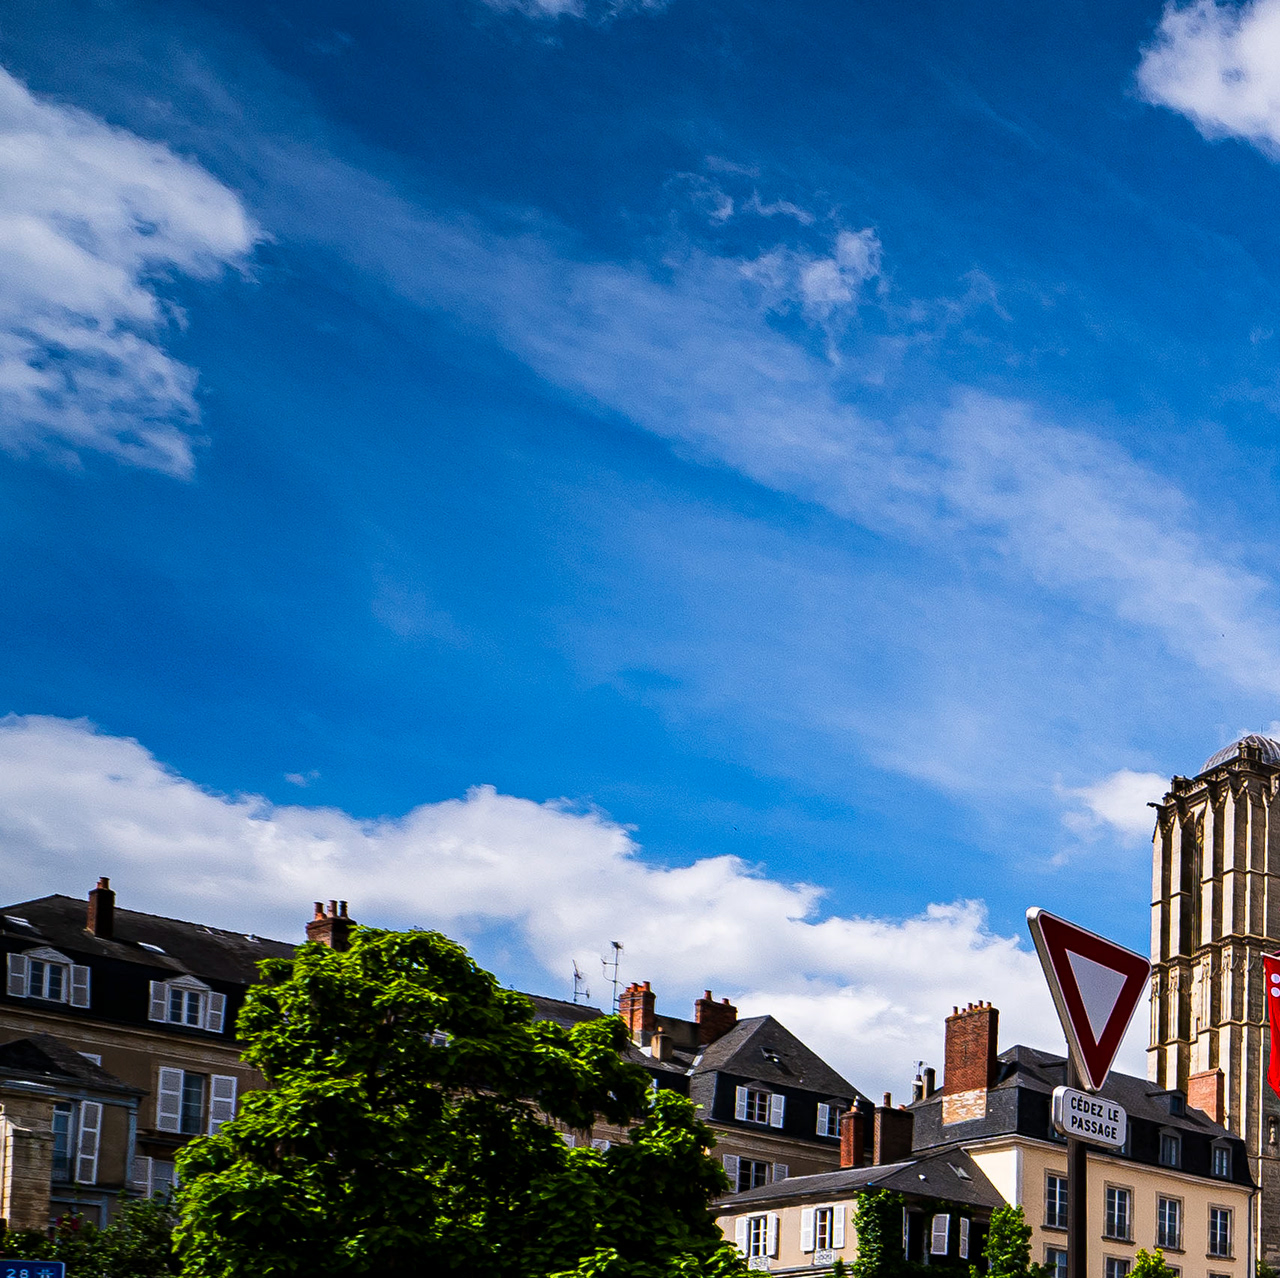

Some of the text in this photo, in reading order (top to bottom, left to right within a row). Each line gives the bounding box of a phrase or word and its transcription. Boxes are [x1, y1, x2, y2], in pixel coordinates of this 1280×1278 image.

[1070, 1095, 1120, 1123] CÉDEZ LE
[1071, 1114, 1118, 1140] PASSAGE
